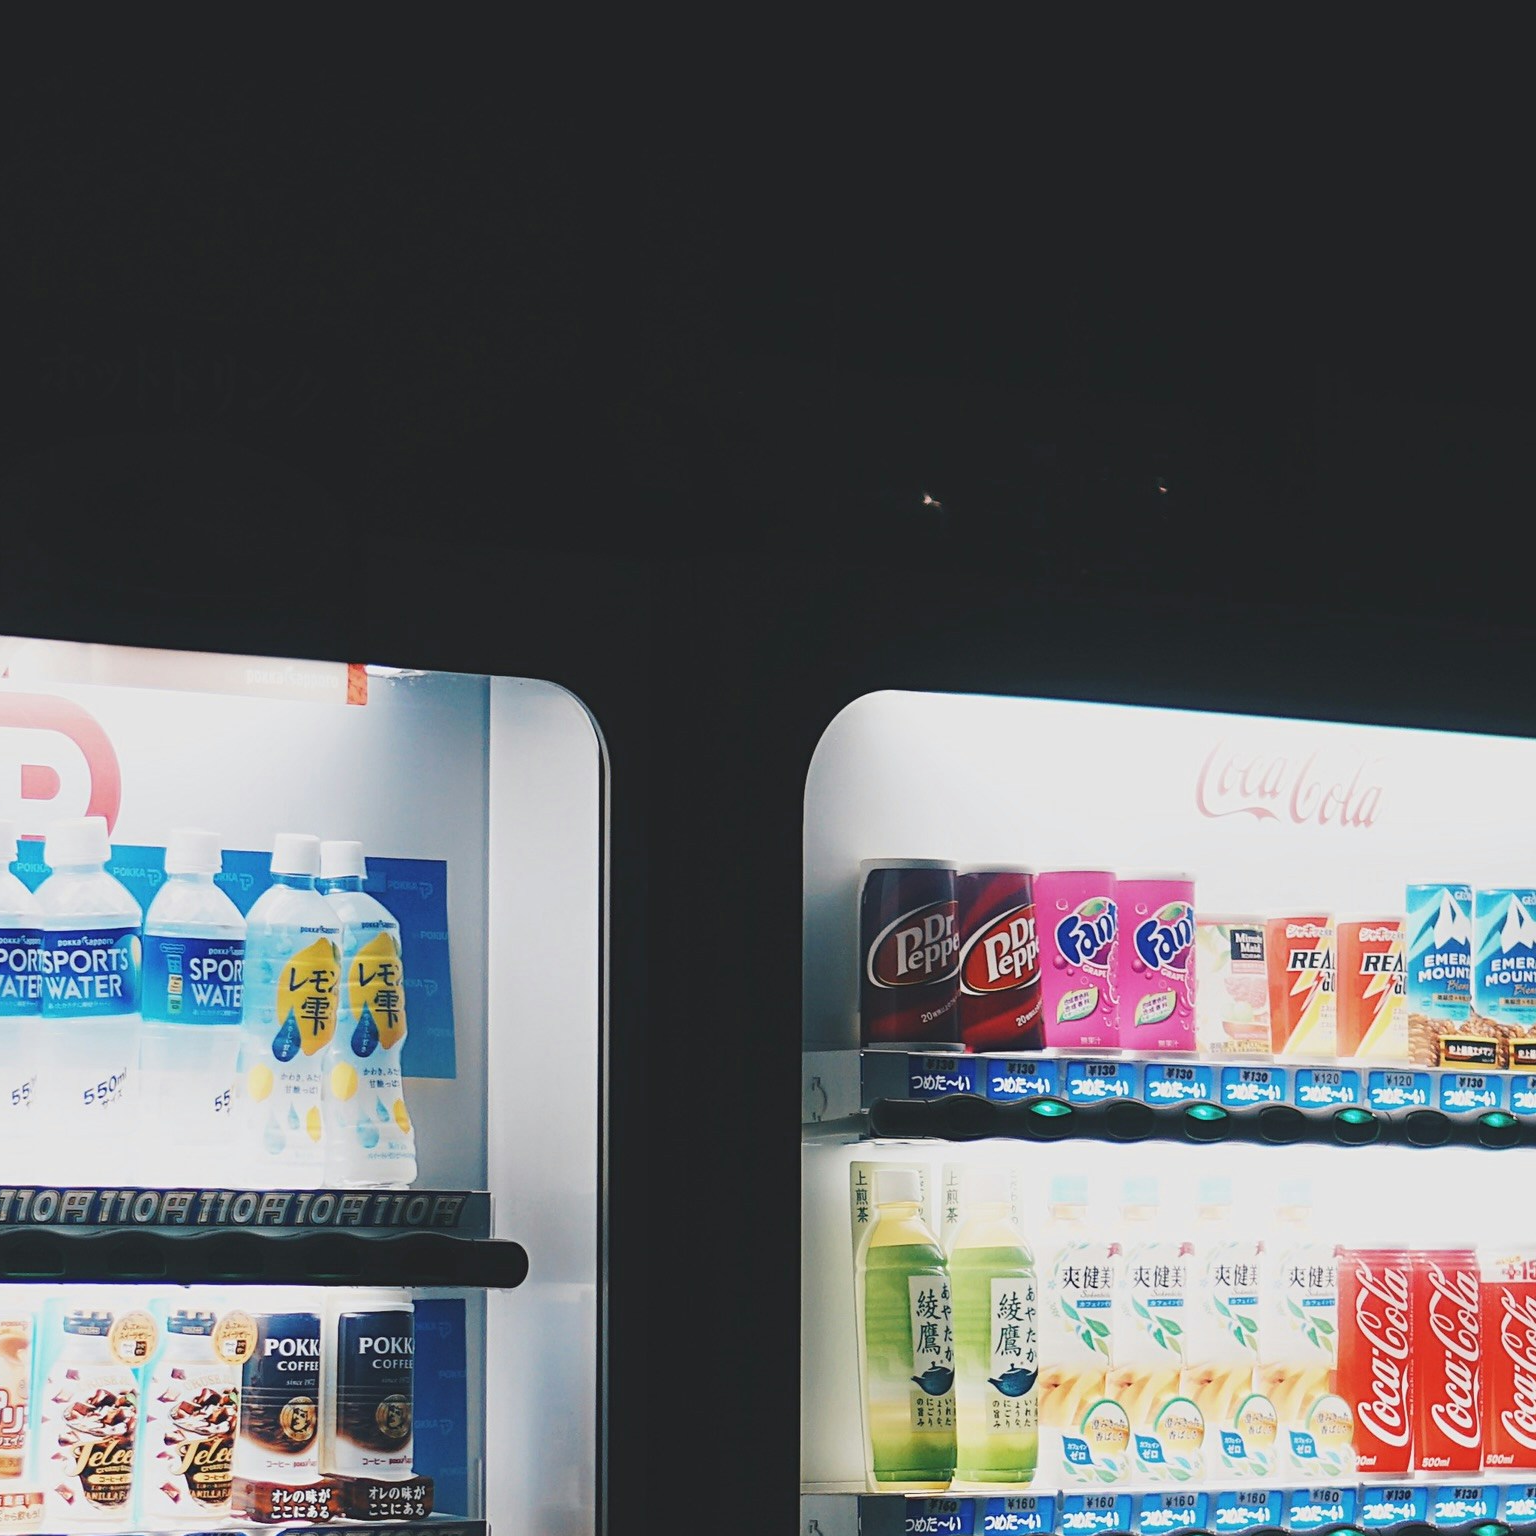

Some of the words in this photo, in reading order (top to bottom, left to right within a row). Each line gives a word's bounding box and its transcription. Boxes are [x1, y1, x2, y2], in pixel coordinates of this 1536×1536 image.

[1196, 740, 1386, 829] Coca-Cola
[923, 913, 955, 940] Dr
[1014, 917, 1035, 940] Dr
[43, 949, 128, 973] SPORTS
[45, 976, 122, 999] WATER
[301, 997, 329, 1035] 雫
[374, 990, 399, 1028] 雫
[925, 1058, 955, 1071] ¥130
[1007, 1062, 1035, 1075] ¥130
[1088, 1064, 1116, 1076] ¥130
[1165, 1068, 1193, 1080] ¥130
[1242, 1070, 1269, 1083] ¥130
[1314, 1073, 1339, 1084] ¥120
[1386, 1075, 1411, 1086] ¥120
[84, 1067, 127, 1105] 550ml
[1459, 1076, 1483, 1089] ¥130
[855, 1170, 869, 1223] 上煎茶
[945, 1171, 959, 1223] 上煎茶
[916, 1289, 941, 1356] 綾鷹
[995, 1293, 1024, 1356] 綾鷹
[1355, 1257, 1411, 1447] Coca-Cola
[1428, 1260, 1480, 1449] Coca-Cola
[1070, 1450, 1086, 1462] ゼロ
[1422, 1456, 1450, 1469] 500ml
[1486, 1453, 1514, 1466] 500ml
[272, 1489, 331, 1504] オレの味が
[368, 1486, 426, 1501] オレの味が
[368, 1503, 426, 1516] ここにある
[928, 1499, 957, 1512] ¥160
[1007, 1497, 1035, 1510] ¥160
[1086, 1496, 1114, 1509] ¥160
[271, 1506, 331, 1520] ここにある
